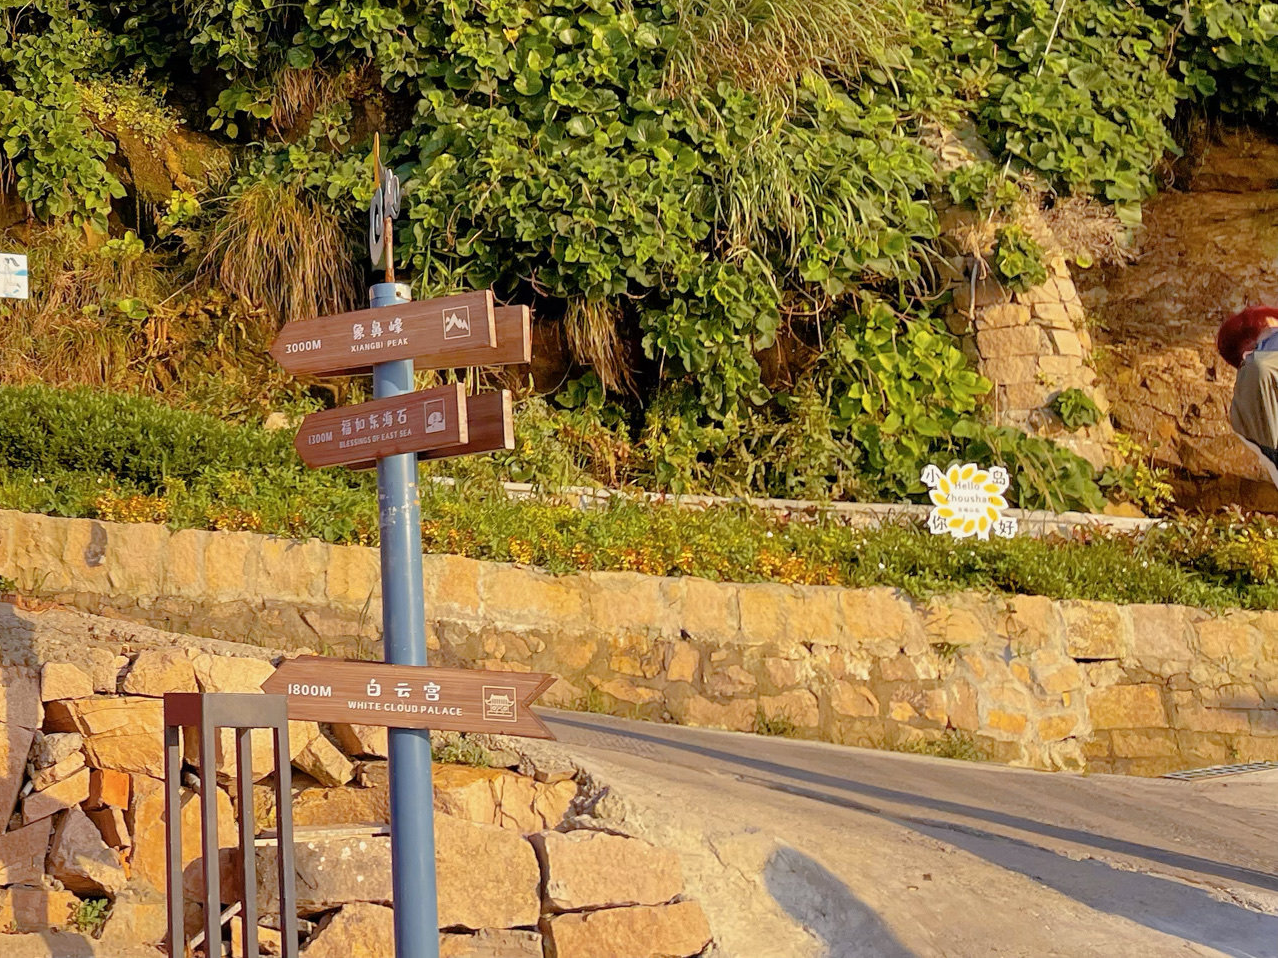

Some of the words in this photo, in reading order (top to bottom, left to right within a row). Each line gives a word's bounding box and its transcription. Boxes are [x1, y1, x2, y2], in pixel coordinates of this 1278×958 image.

[352, 317, 404, 340] 象鼻峰
[285, 339, 322, 354] 3000M
[350, 341, 384, 353] XIANGBI
[387, 337, 409, 348] PEAK
[340, 408, 408, 436] 福如东海石
[308, 431, 333, 446] 1300M
[339, 435, 372, 449] BLESSINGS
[372, 434, 381, 443] OF
[381, 430, 398, 441] EAST
[399, 428, 412, 438] SEA
[926, 468, 941, 483] 小
[954, 482, 980, 490] Hello
[932, 515, 948, 531] 你
[998, 520, 1014, 535] 好
[287, 683, 332, 698] 1800M
[366, 679, 442, 702] 白云宫
[347, 700, 382, 712] WHITE
[383, 702, 419, 714] CLOUD
[420, 704, 464, 717] PALACE
